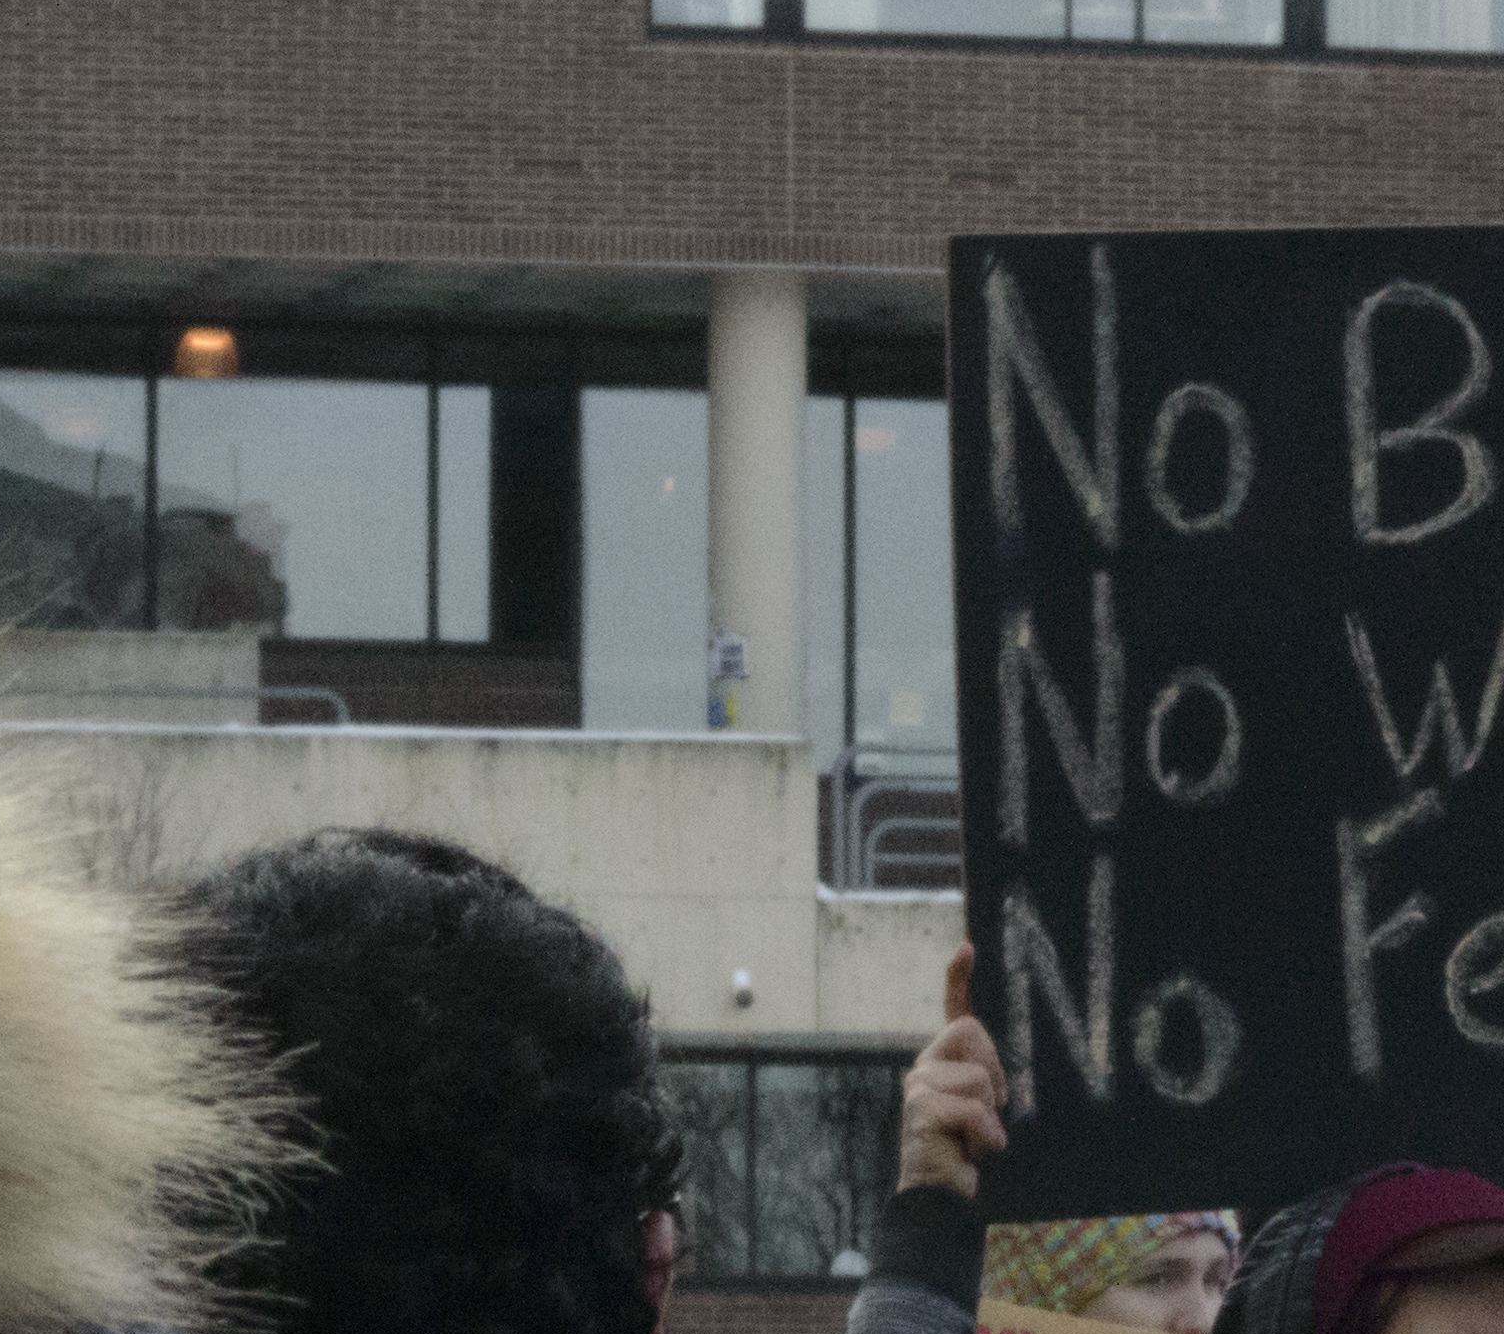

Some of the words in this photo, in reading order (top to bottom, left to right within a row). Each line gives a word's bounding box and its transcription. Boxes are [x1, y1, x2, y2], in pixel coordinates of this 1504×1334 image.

[986, 243, 1254, 555] No
[997, 571, 1242, 847] No
[1002, 856, 1242, 1119] No
